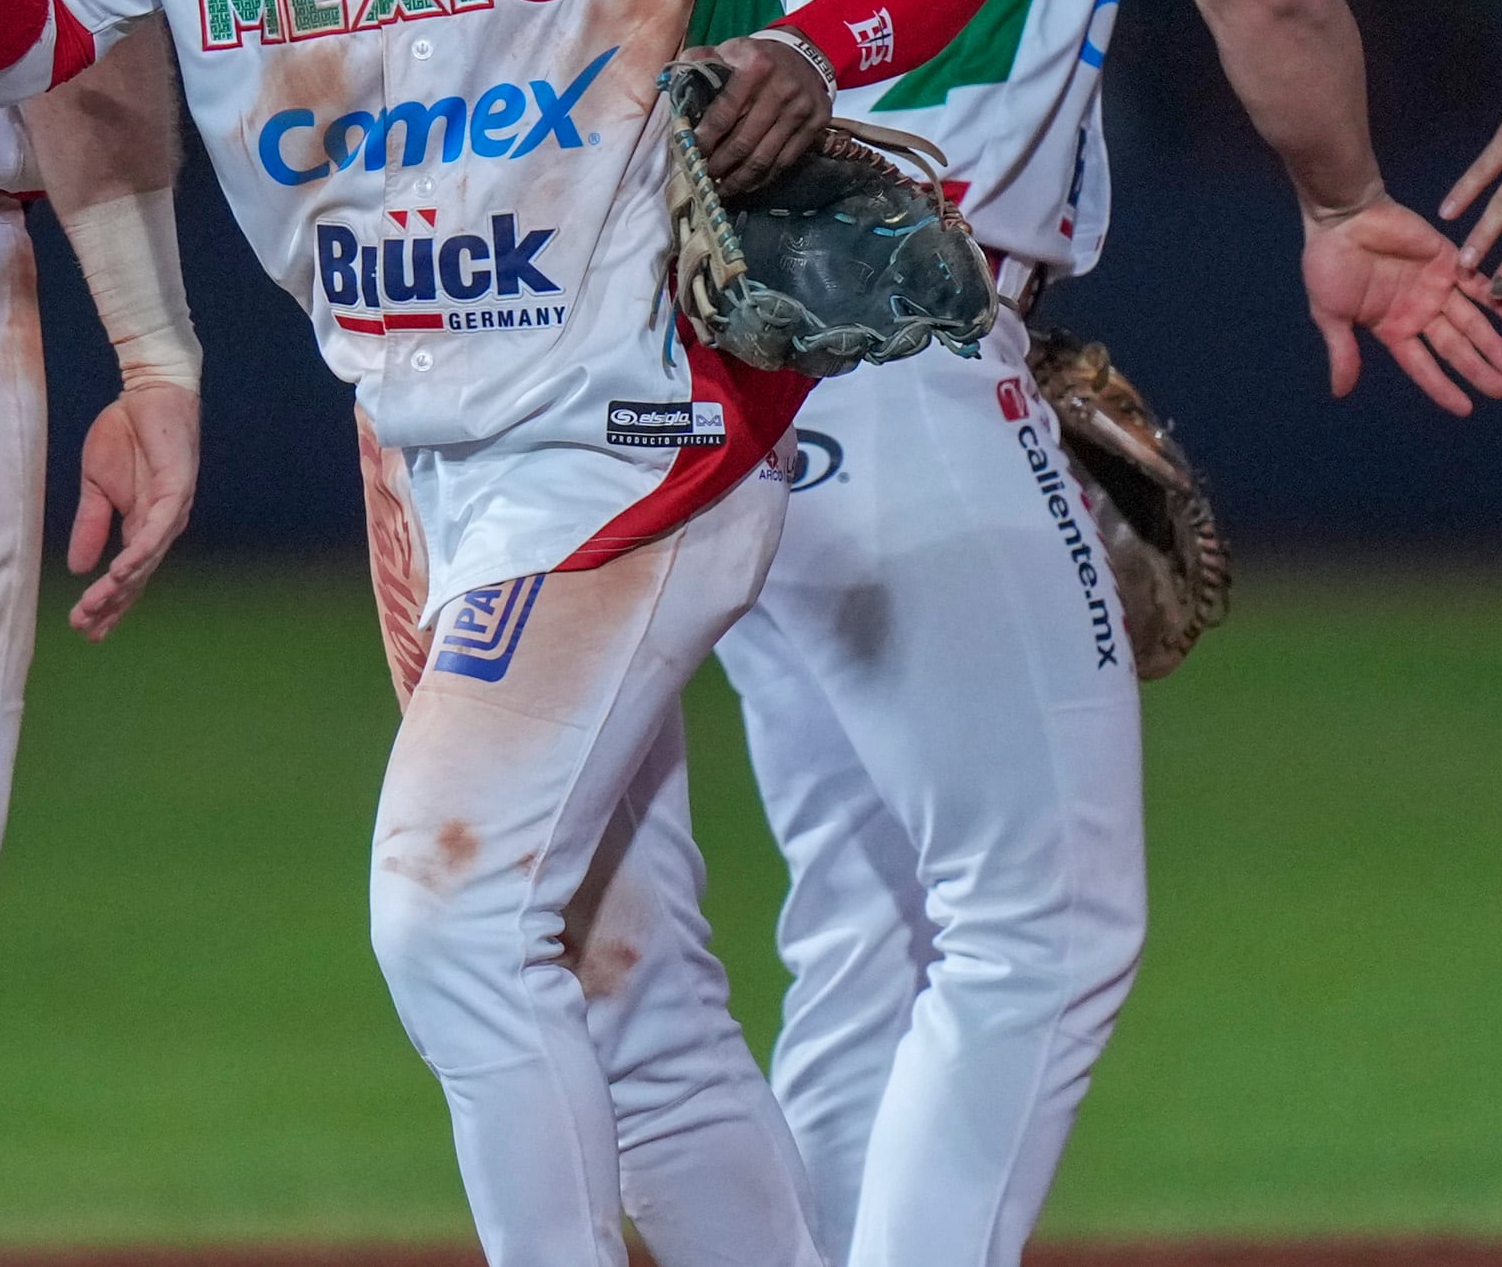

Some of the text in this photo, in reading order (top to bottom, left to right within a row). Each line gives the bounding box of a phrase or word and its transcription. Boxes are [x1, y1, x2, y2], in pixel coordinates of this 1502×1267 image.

[793, 41, 835, 83] BEAST
[448, 305, 566, 331] GERMANY
[611, 434, 722, 445] PRODUCTO OFICIAL
[1017, 425, 1119, 671] caliente.mx
